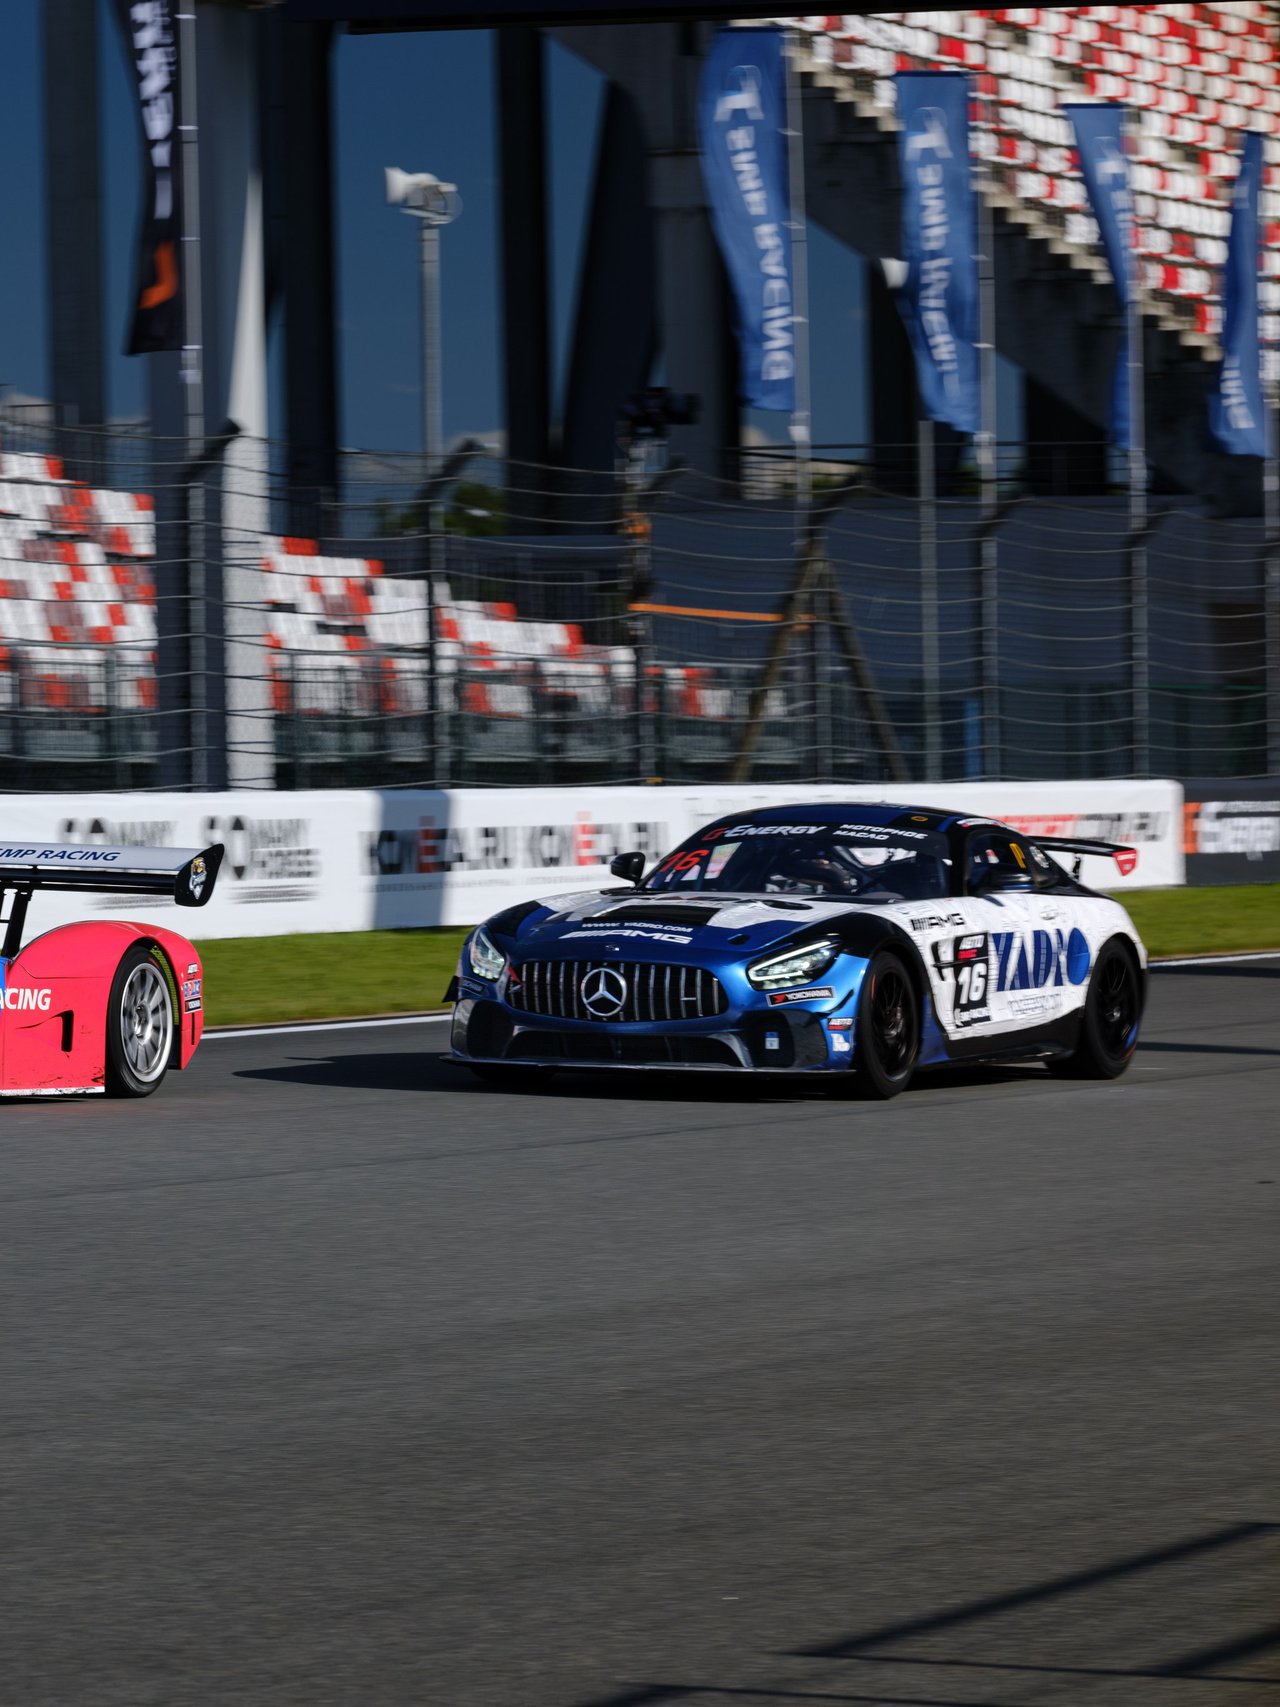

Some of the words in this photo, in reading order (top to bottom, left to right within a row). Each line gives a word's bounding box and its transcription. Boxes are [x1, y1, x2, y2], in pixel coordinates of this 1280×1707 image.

[36, 850, 121, 862] RACING
[660, 849, 710, 873] 16
[958, 962, 988, 1004] 16
